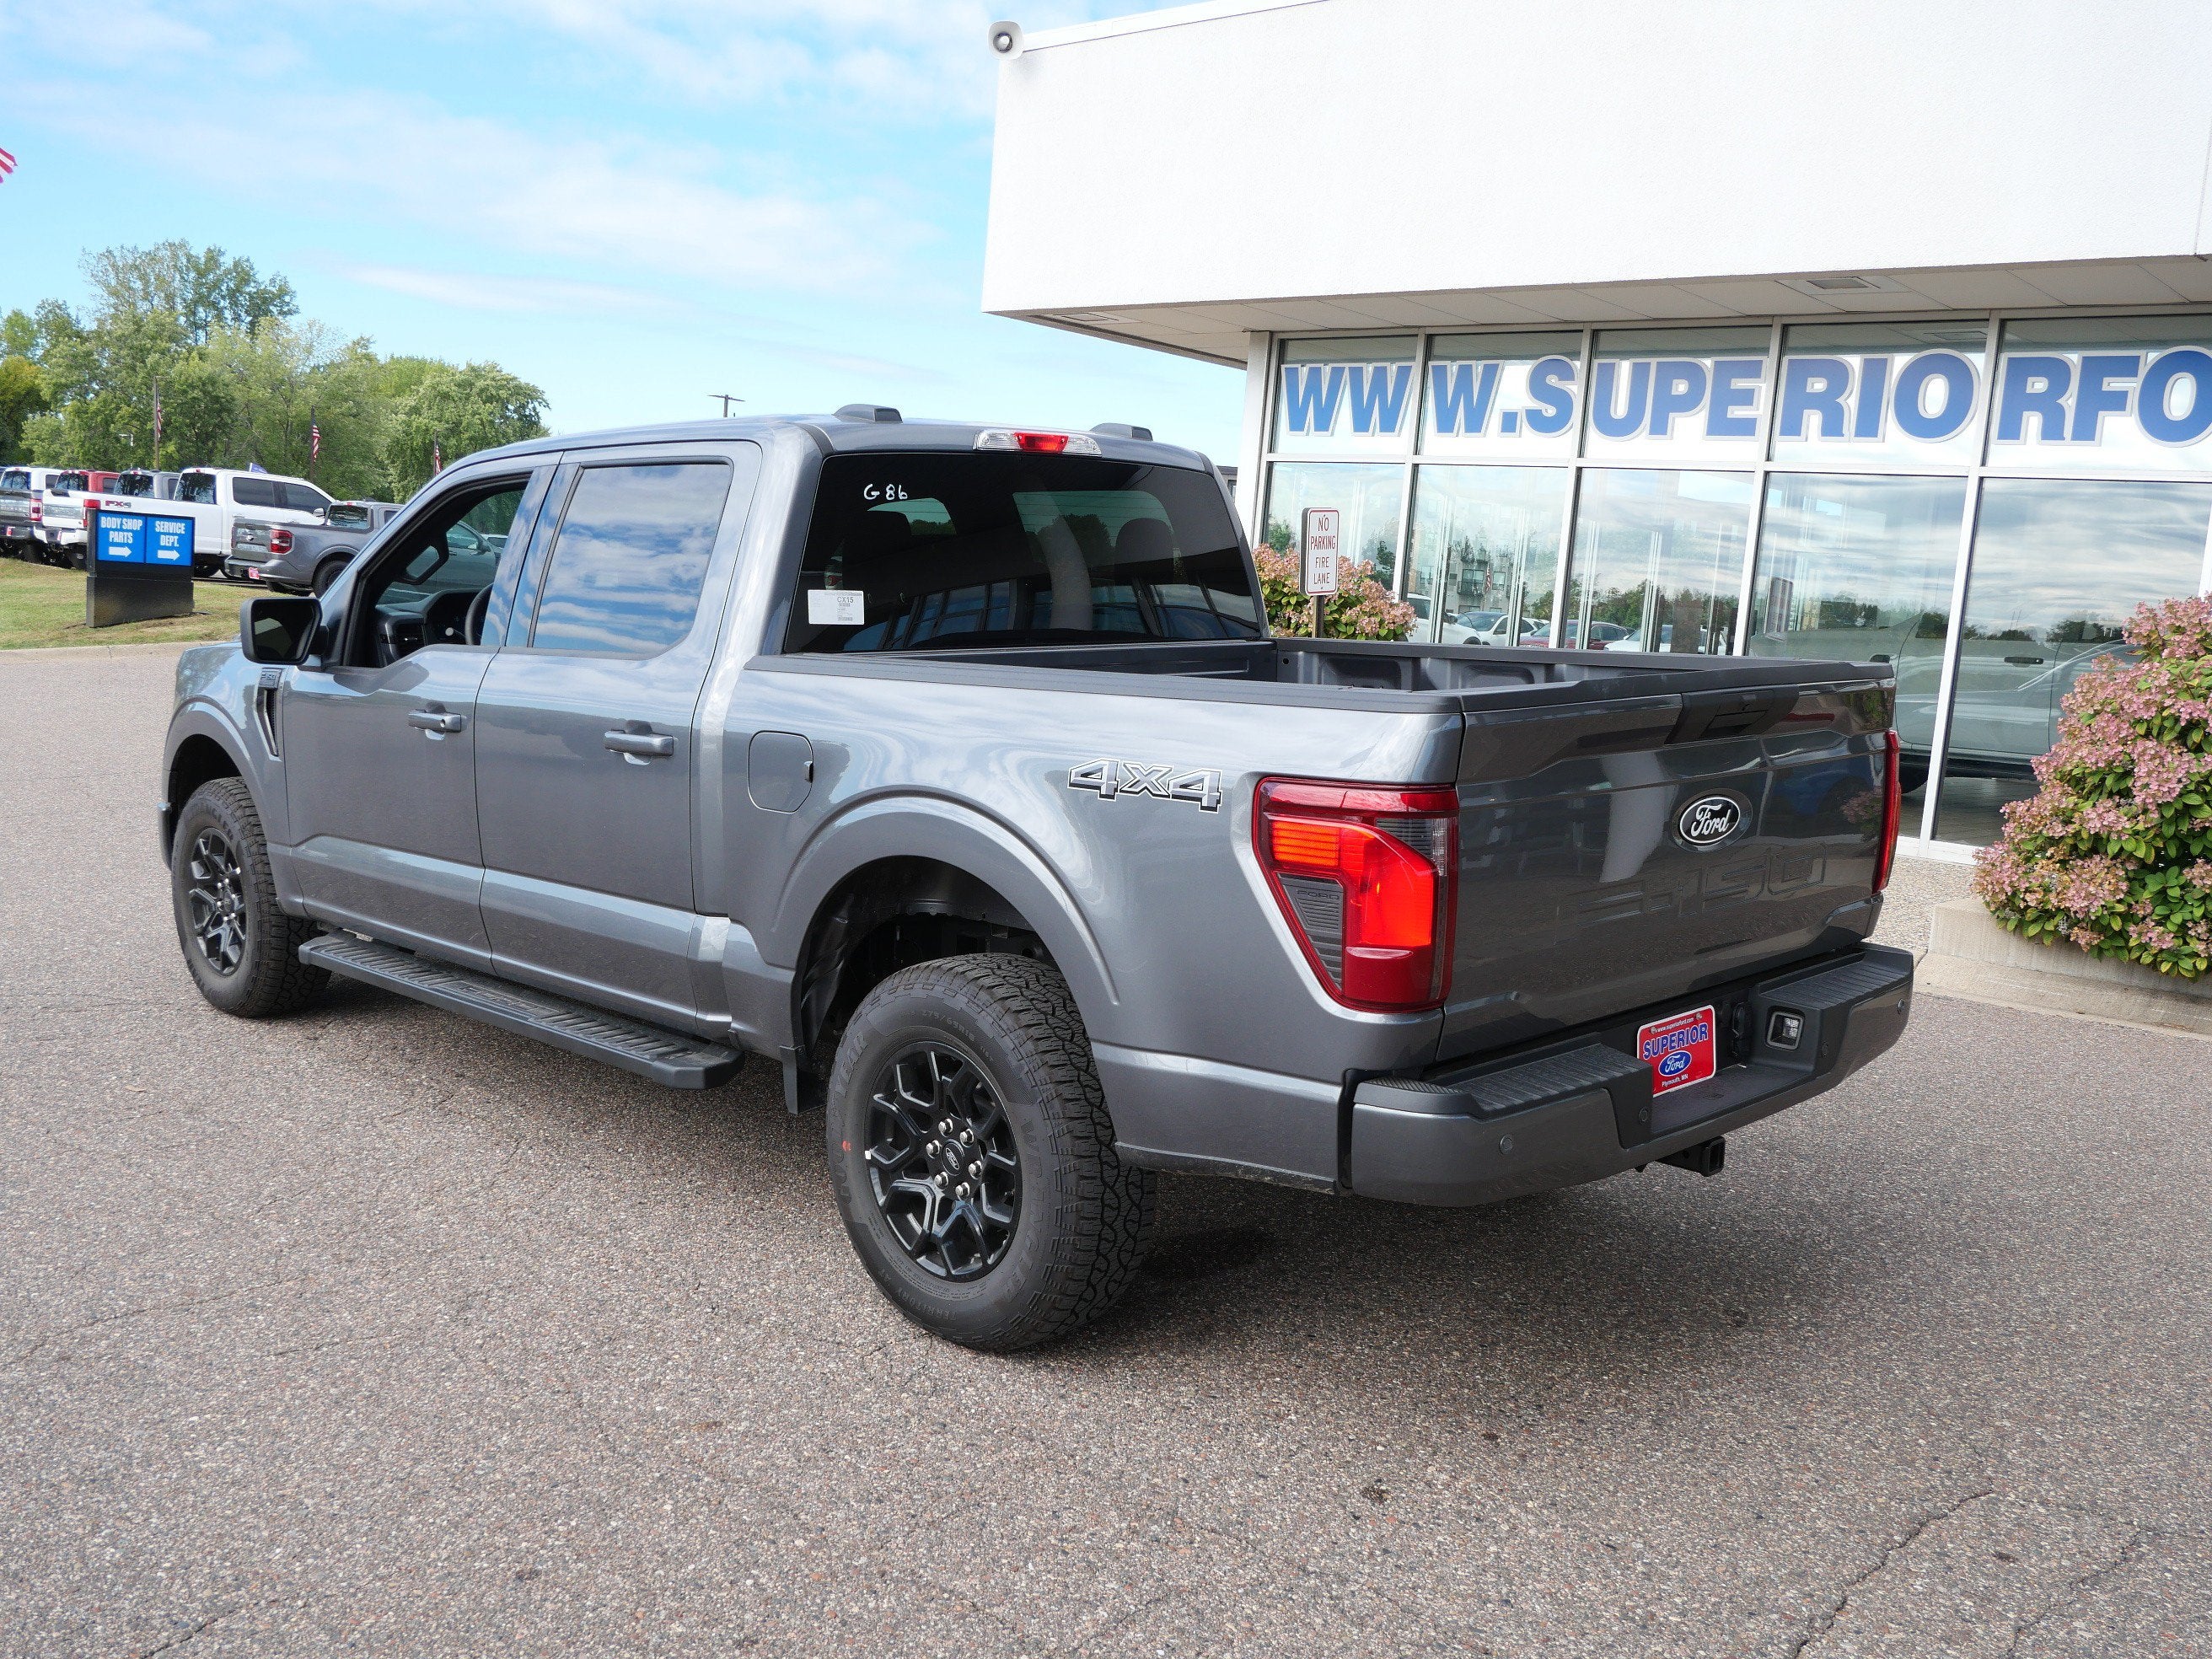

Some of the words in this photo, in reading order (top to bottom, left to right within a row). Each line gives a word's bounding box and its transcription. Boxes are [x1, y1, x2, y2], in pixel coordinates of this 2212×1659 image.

[101, 516, 121, 529] BODY
[122, 518, 142, 530] SHOP
[155, 520, 185, 534] SERVICE
[1318, 517, 1329, 532] NO
[109, 531, 133, 544] PARTS
[160, 534, 180, 547] DEPT.
[1310, 535, 1336, 550] PARKING
[1315, 556, 1329, 568] FIRE
[1313, 572, 1330, 584] LANE
[1690, 803, 1731, 837] Ford
[1297, 889, 1340, 900] FORD
[1642, 1023, 1709, 1060] SUPERIOR
[1664, 1055, 1686, 1073] Ford
